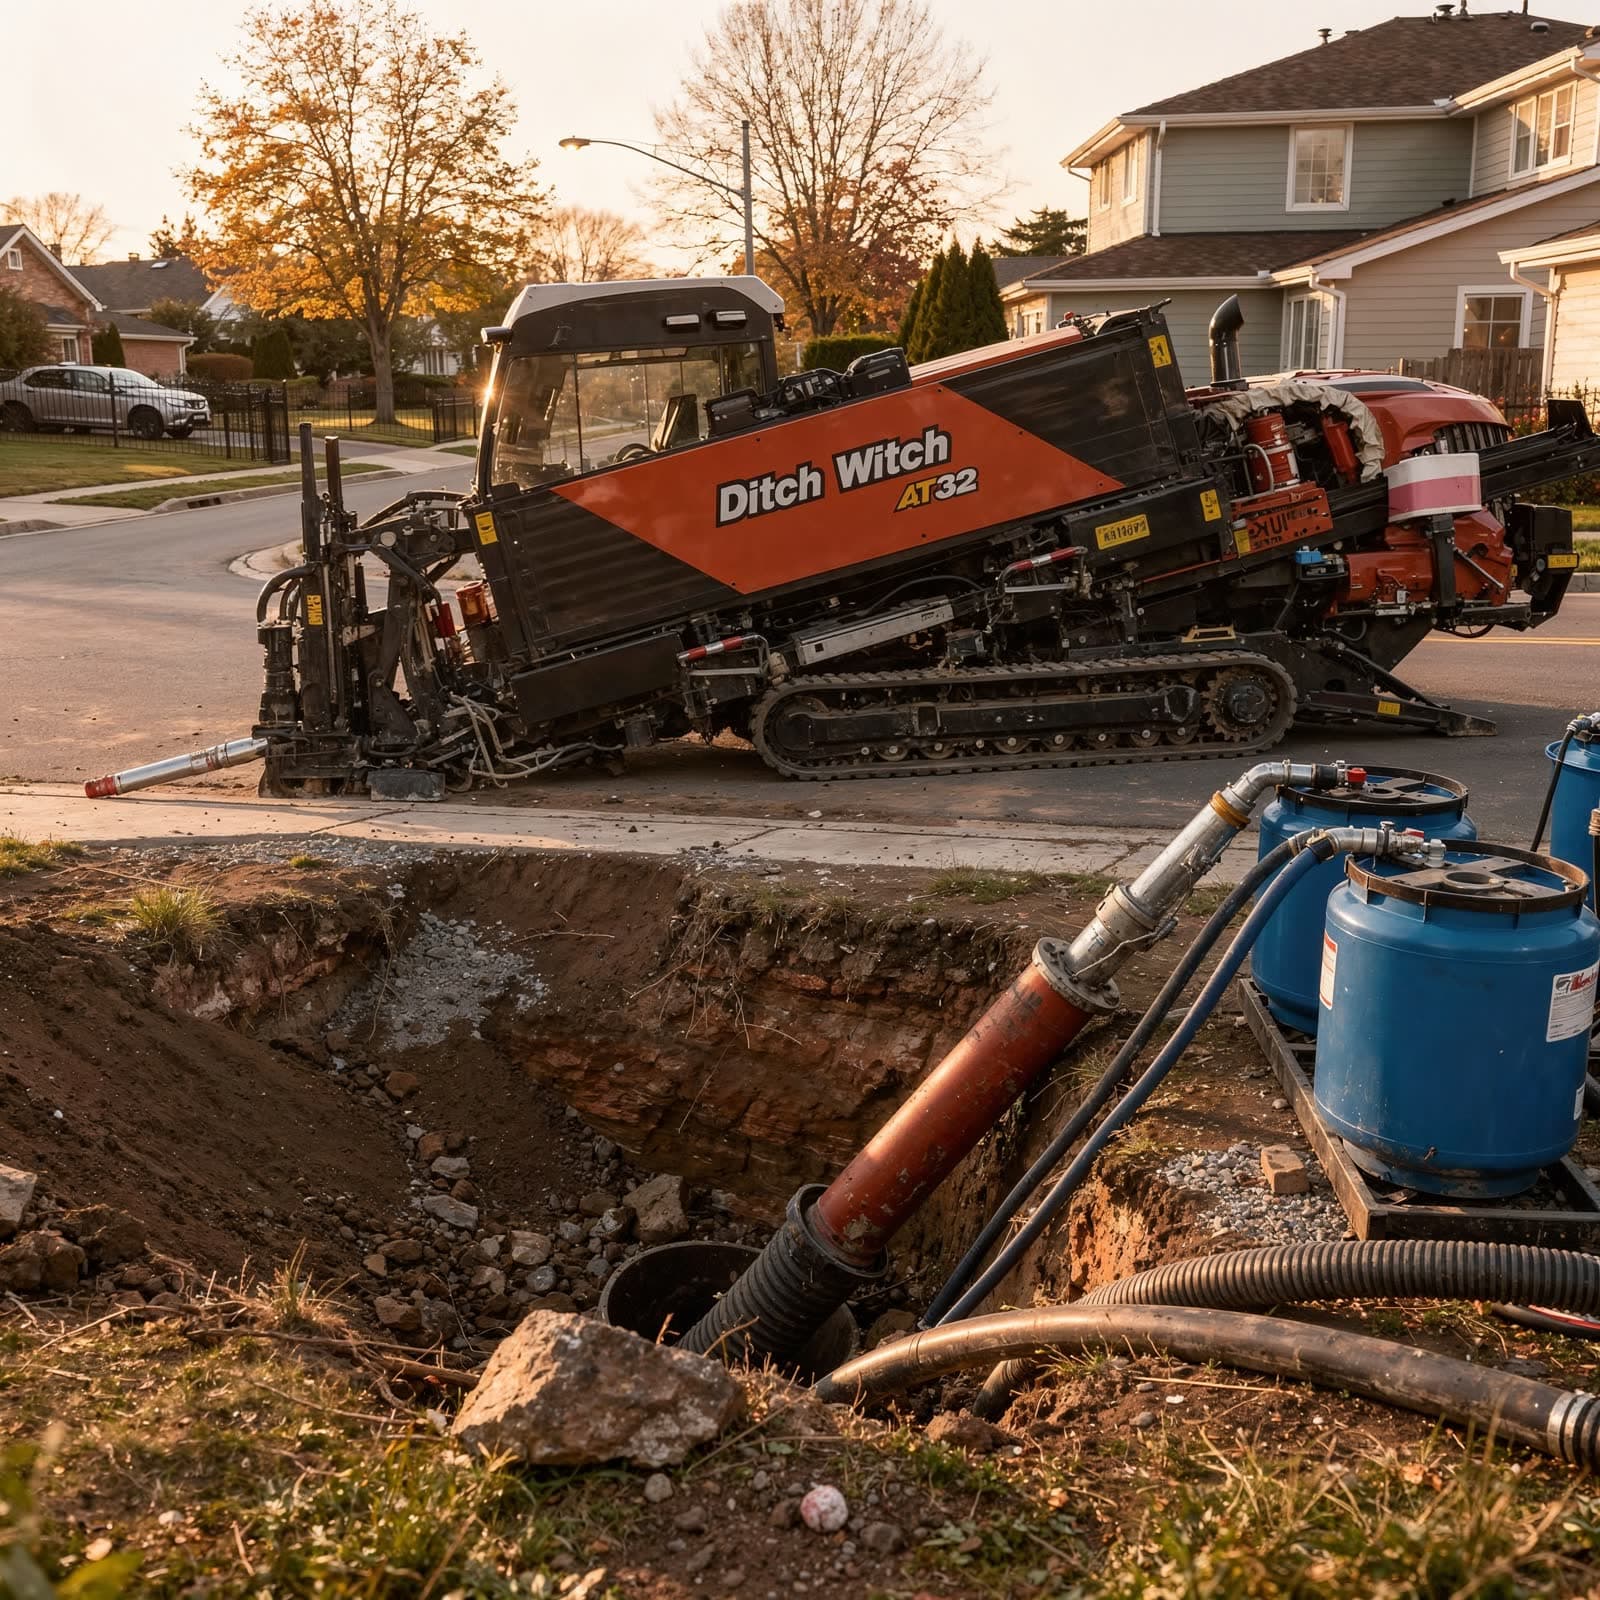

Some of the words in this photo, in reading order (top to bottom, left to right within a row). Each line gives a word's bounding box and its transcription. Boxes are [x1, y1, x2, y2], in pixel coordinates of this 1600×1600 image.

[718, 463, 823, 524] Ditch
[834, 428, 950, 490] Witch
[895, 467, 978, 512] AT32
